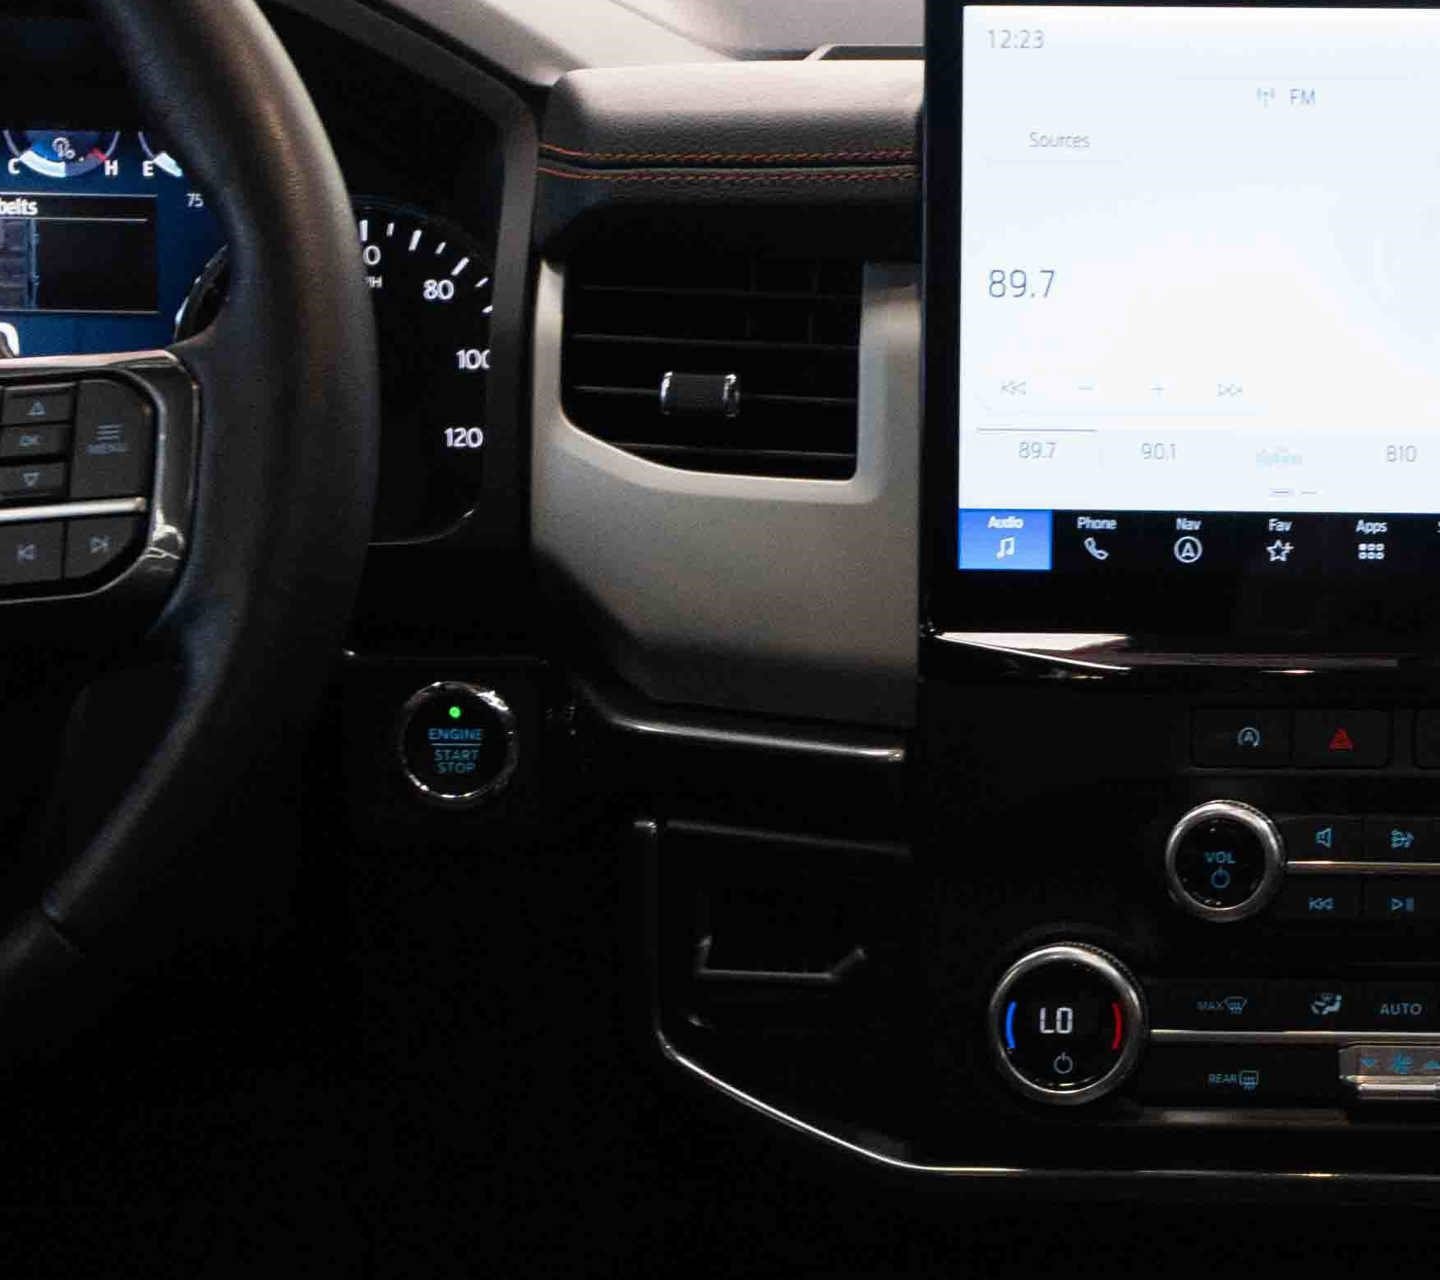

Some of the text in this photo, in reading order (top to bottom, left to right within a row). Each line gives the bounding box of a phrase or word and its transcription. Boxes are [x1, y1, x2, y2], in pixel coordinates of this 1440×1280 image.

[987, 29, 1045, 49] 12:23
[1289, 88, 1318, 105] FM
[1028, 131, 1091, 150] Sources
[8, 158, 20, 174] C
[105, 160, 118, 176] H
[143, 162, 154, 177] E
[423, 279, 454, 300] 80
[988, 269, 1057, 300] 89.7
[444, 427, 484, 448] 120
[1017, 442, 1057, 459] 89.7
[1140, 442, 1177, 461] 90.1
[1384, 445, 1417, 463] 810
[988, 517, 1024, 529] Audio
[1076, 517, 1117, 531] Phone
[1176, 518, 1202, 531] Nav
[1268, 518, 1293, 532] Fav
[1355, 519, 1388, 536] Apps
[427, 728, 481, 740] ENGINE
[433, 749, 479, 761] START
[438, 762, 476, 773] STOP
[1205, 851, 1236, 865] VOL
[1197, 1000, 1224, 1011] MAX
[1379, 1002, 1422, 1016] AUTO
[1039, 1006, 1073, 1034] LO
[1208, 1073, 1237, 1084] REAR
